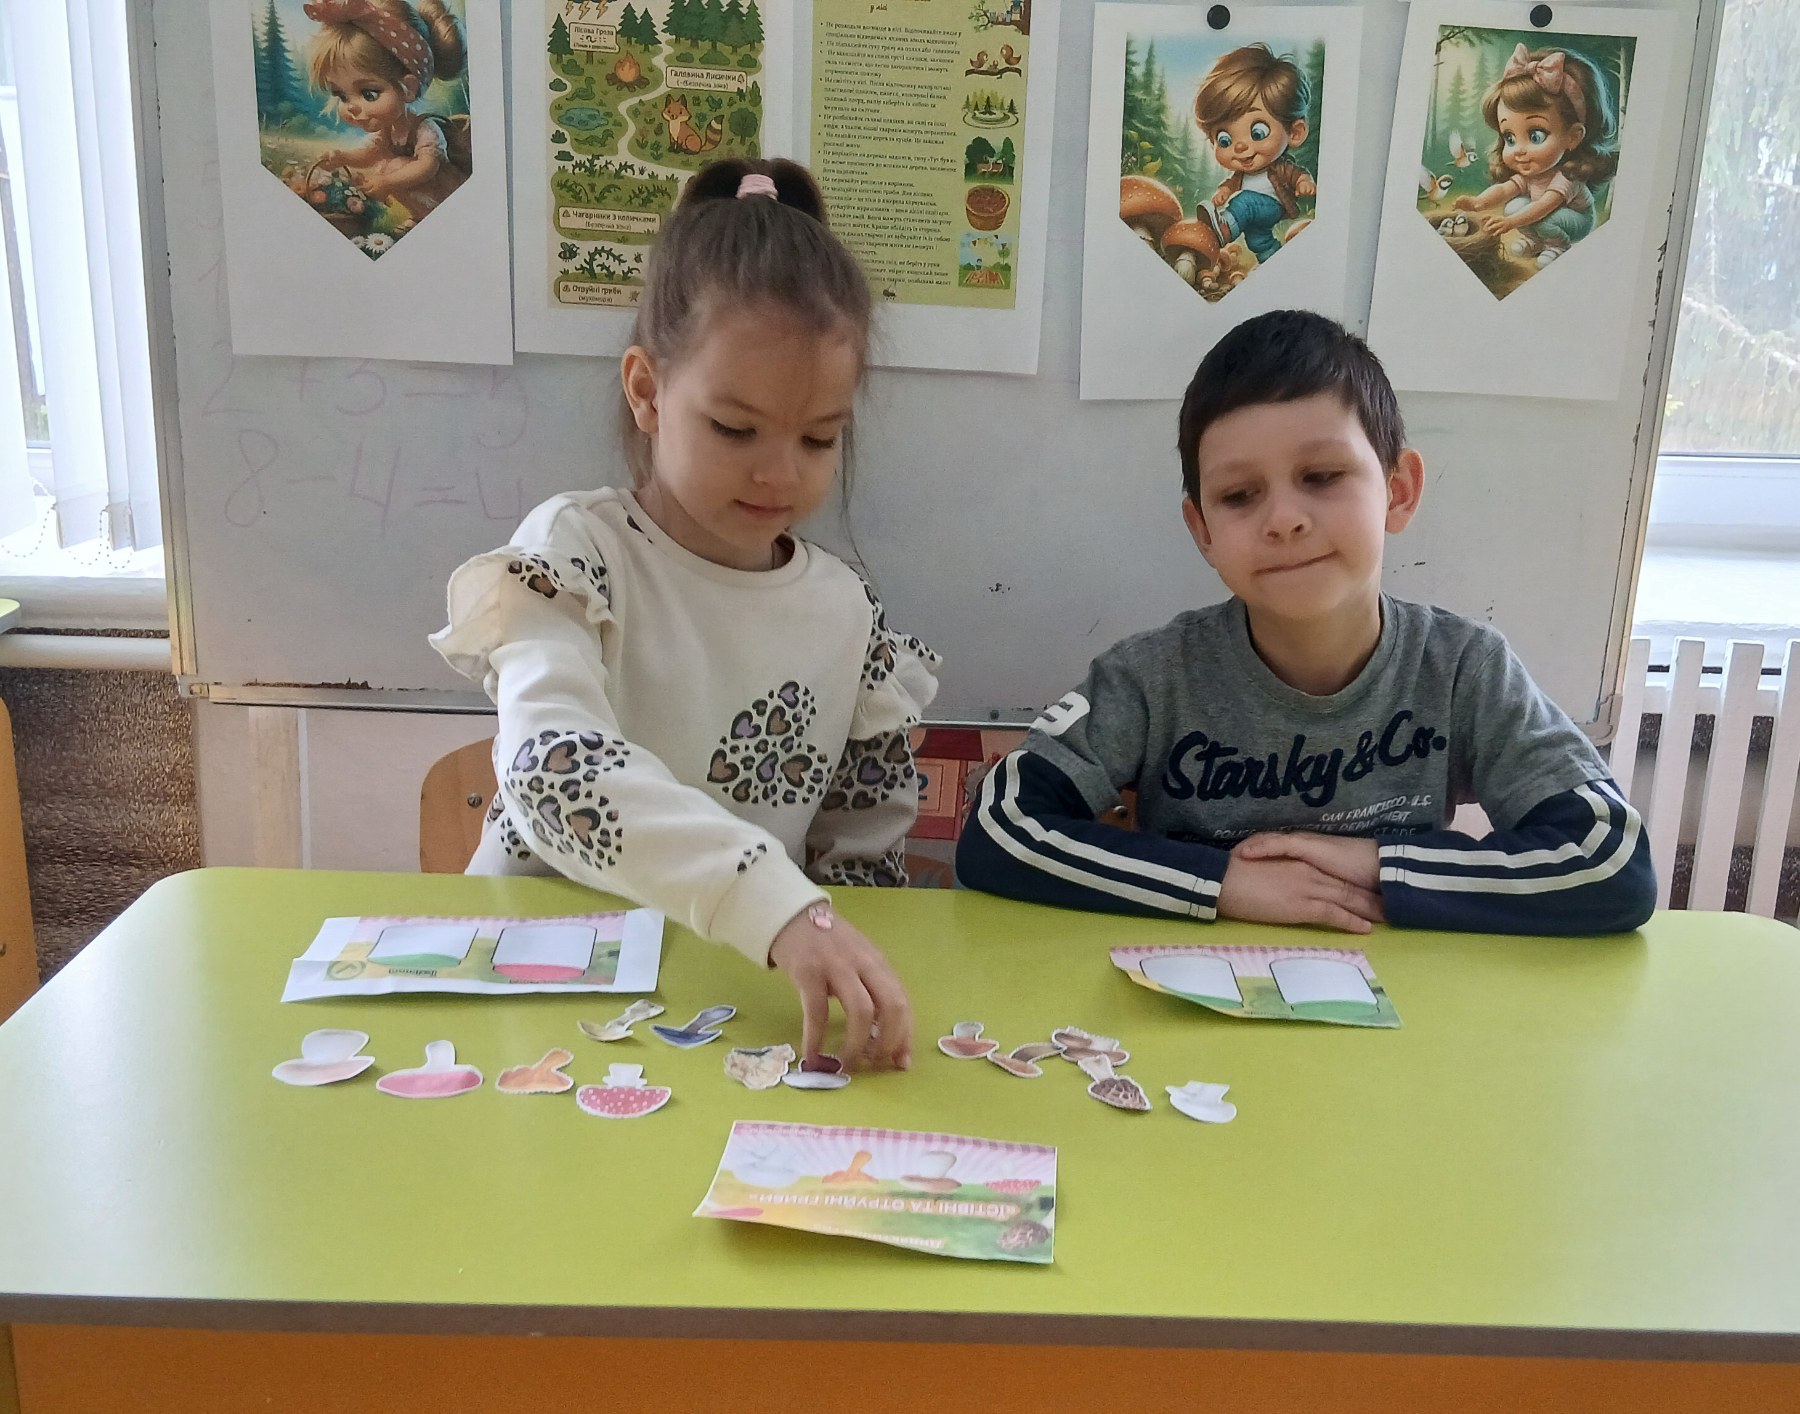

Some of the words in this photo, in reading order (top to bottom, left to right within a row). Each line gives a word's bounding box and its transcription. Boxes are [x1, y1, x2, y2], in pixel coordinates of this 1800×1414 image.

[1162, 730, 1345, 807] Starsky
[1377, 710, 1447, 766] Co.
[1319, 811, 1344, 822] SAN
[1345, 795, 1407, 820] FRANCISCO
[824, 1195, 906, 1212] ОТРУЙНІ
[910, 1200, 933, 1214] ТА
